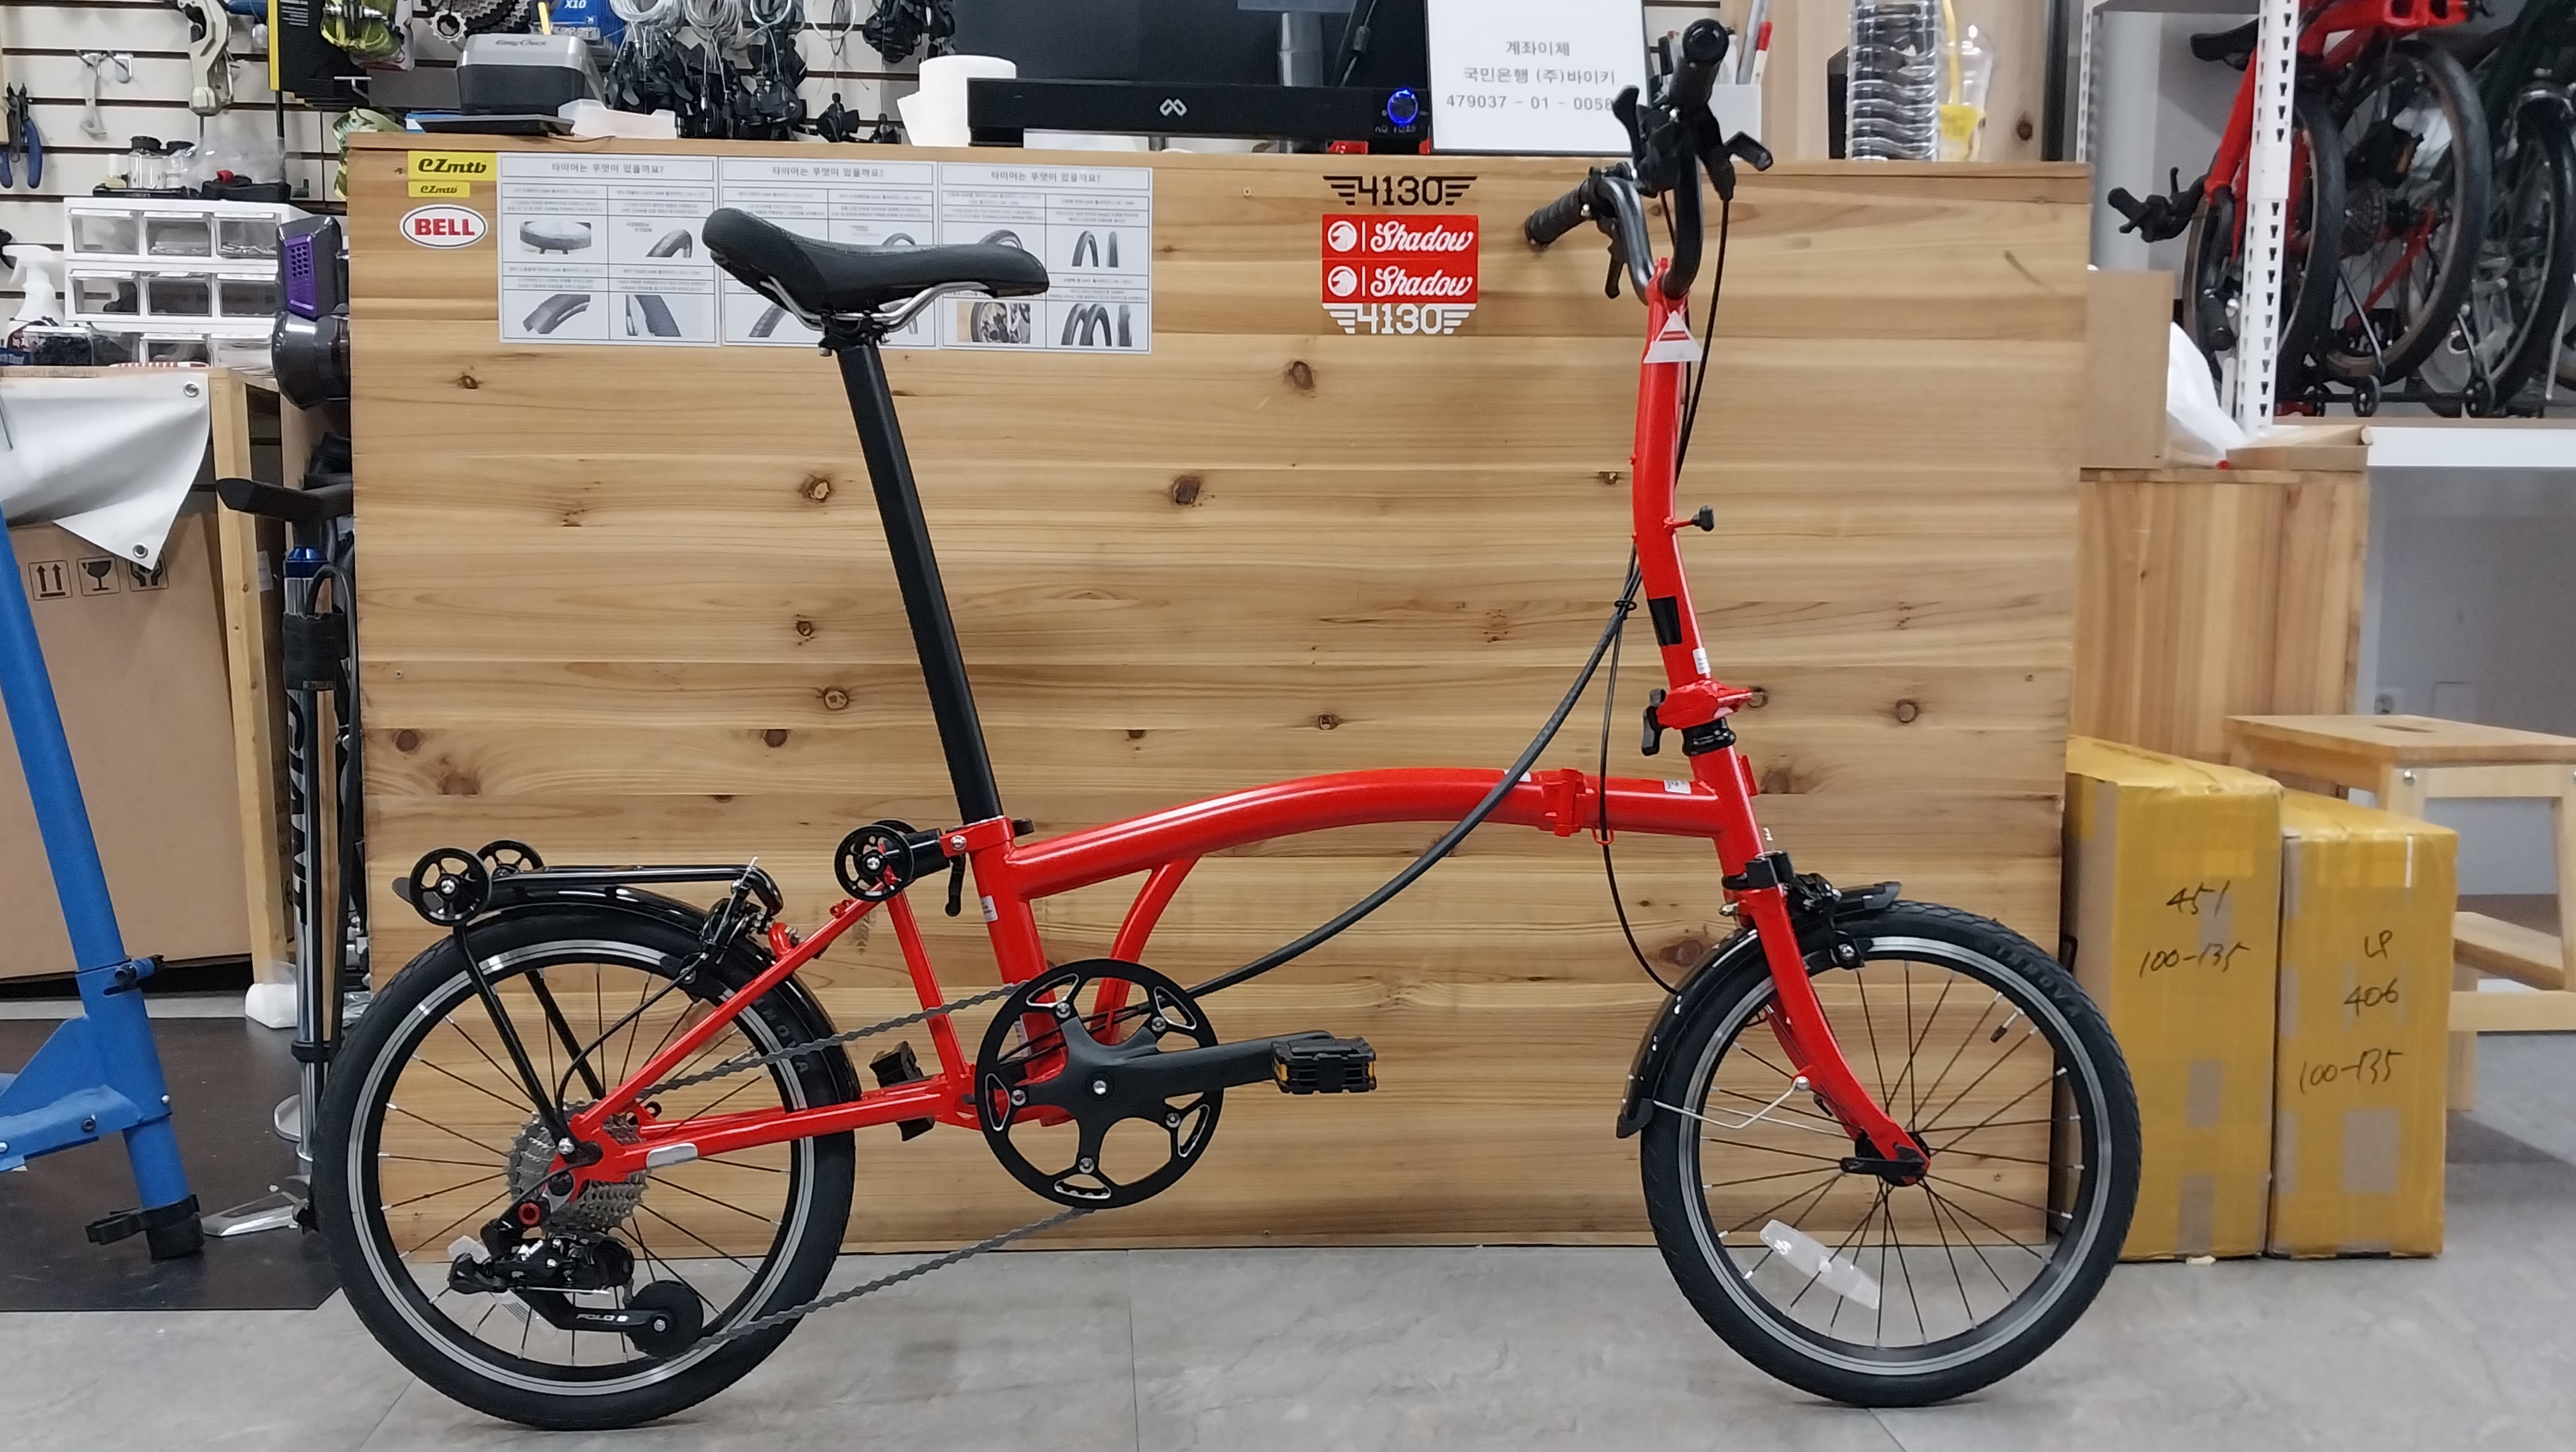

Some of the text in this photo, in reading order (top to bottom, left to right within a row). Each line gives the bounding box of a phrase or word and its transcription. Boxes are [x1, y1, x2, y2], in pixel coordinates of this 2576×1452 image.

[564, 0, 587, 8] X10
[1506, 41, 1570, 57] 계좌이체
[1463, 67, 1615, 85] 국민은행 (주)바이키
[1446, 94, 1507, 108] 479037
[1530, 96, 1549, 110] 01
[551, 162, 588, 173] 타이어는
[772, 166, 809, 176] 타이어는
[990, 171, 1026, 181] 타이어는
[1358, 175, 1443, 206] 4130
[414, 218, 475, 236] BELL
[1370, 220, 1474, 252] Shadow
[1370, 265, 1474, 297] Shadow
[1357, 304, 1443, 335] 4130
[2165, 880, 2230, 916] 451
[2140, 941, 2249, 976] 100-135
[2344, 978, 2398, 1016] 406
[2298, 1048, 2403, 1093] 100-135
